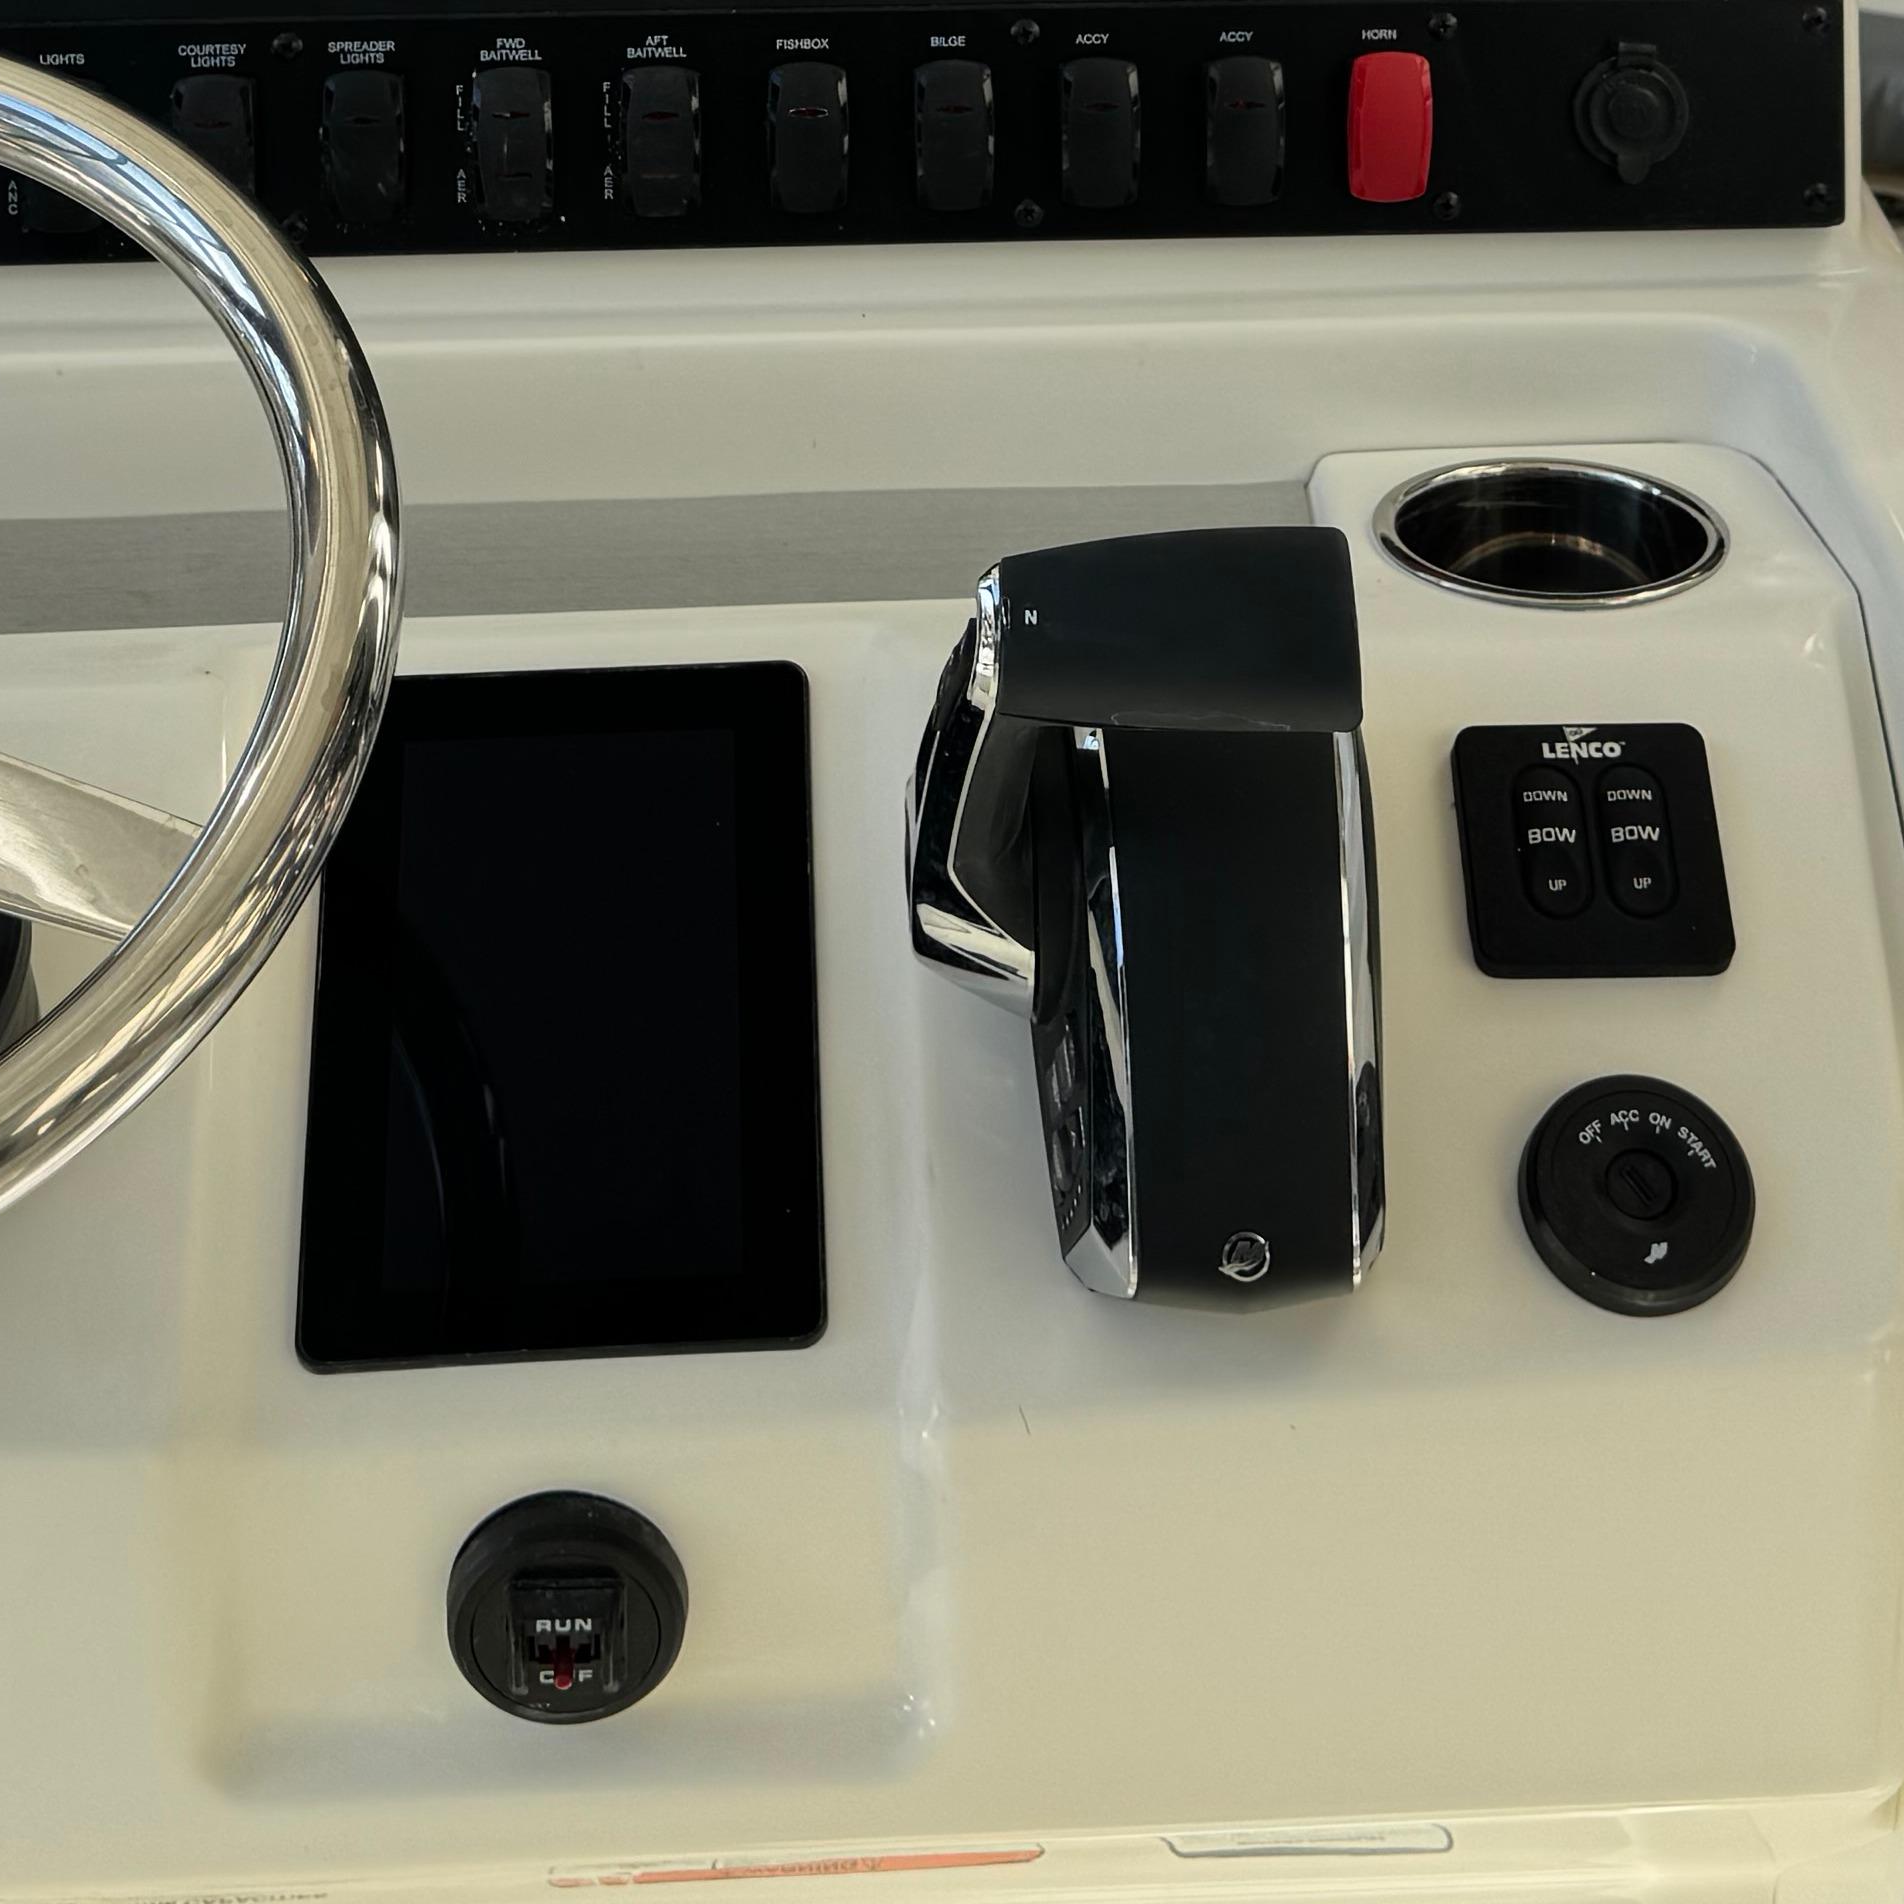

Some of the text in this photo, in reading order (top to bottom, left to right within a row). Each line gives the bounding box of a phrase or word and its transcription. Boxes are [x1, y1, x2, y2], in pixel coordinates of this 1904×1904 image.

[645, 35, 670, 47] AFT
[930, 35, 967, 47] BILGE
[1075, 33, 1110, 45] ACCY
[1219, 30, 1254, 43] ACCY
[1361, 28, 1398, 41] HORN
[177, 43, 247, 57] COURTESY
[327, 40, 396, 53] SPREADER
[495, 37, 527, 50] FWD
[776, 37, 830, 50] FISHBOX
[39, 53, 86, 66] LIGHTS
[339, 52, 386, 65] LIGHTS
[479, 49, 544, 62] BAITWELL
[626, 47, 688, 59] BAITWELL
[190, 55, 237, 68] LIGHTS
[455, 84, 465, 132] FILL
[602, 81, 612, 129] FILL
[456, 168, 467, 204] AER
[603, 165, 614, 200] AER
[7, 179, 19, 216] ANC
[1541, 741, 1623, 760] LENCO
[1523, 790, 1569, 802] DOWN
[1607, 789, 1653, 802] DOWN
[1527, 826, 1577, 845] BOW
[1610, 825, 1660, 843] BOW
[1548, 879, 1568, 892] UP
[1633, 877, 1652, 890] UP
[1578, 1109, 1717, 1170] OFF ACC ON START
[535, 1618, 593, 1633] RUN
